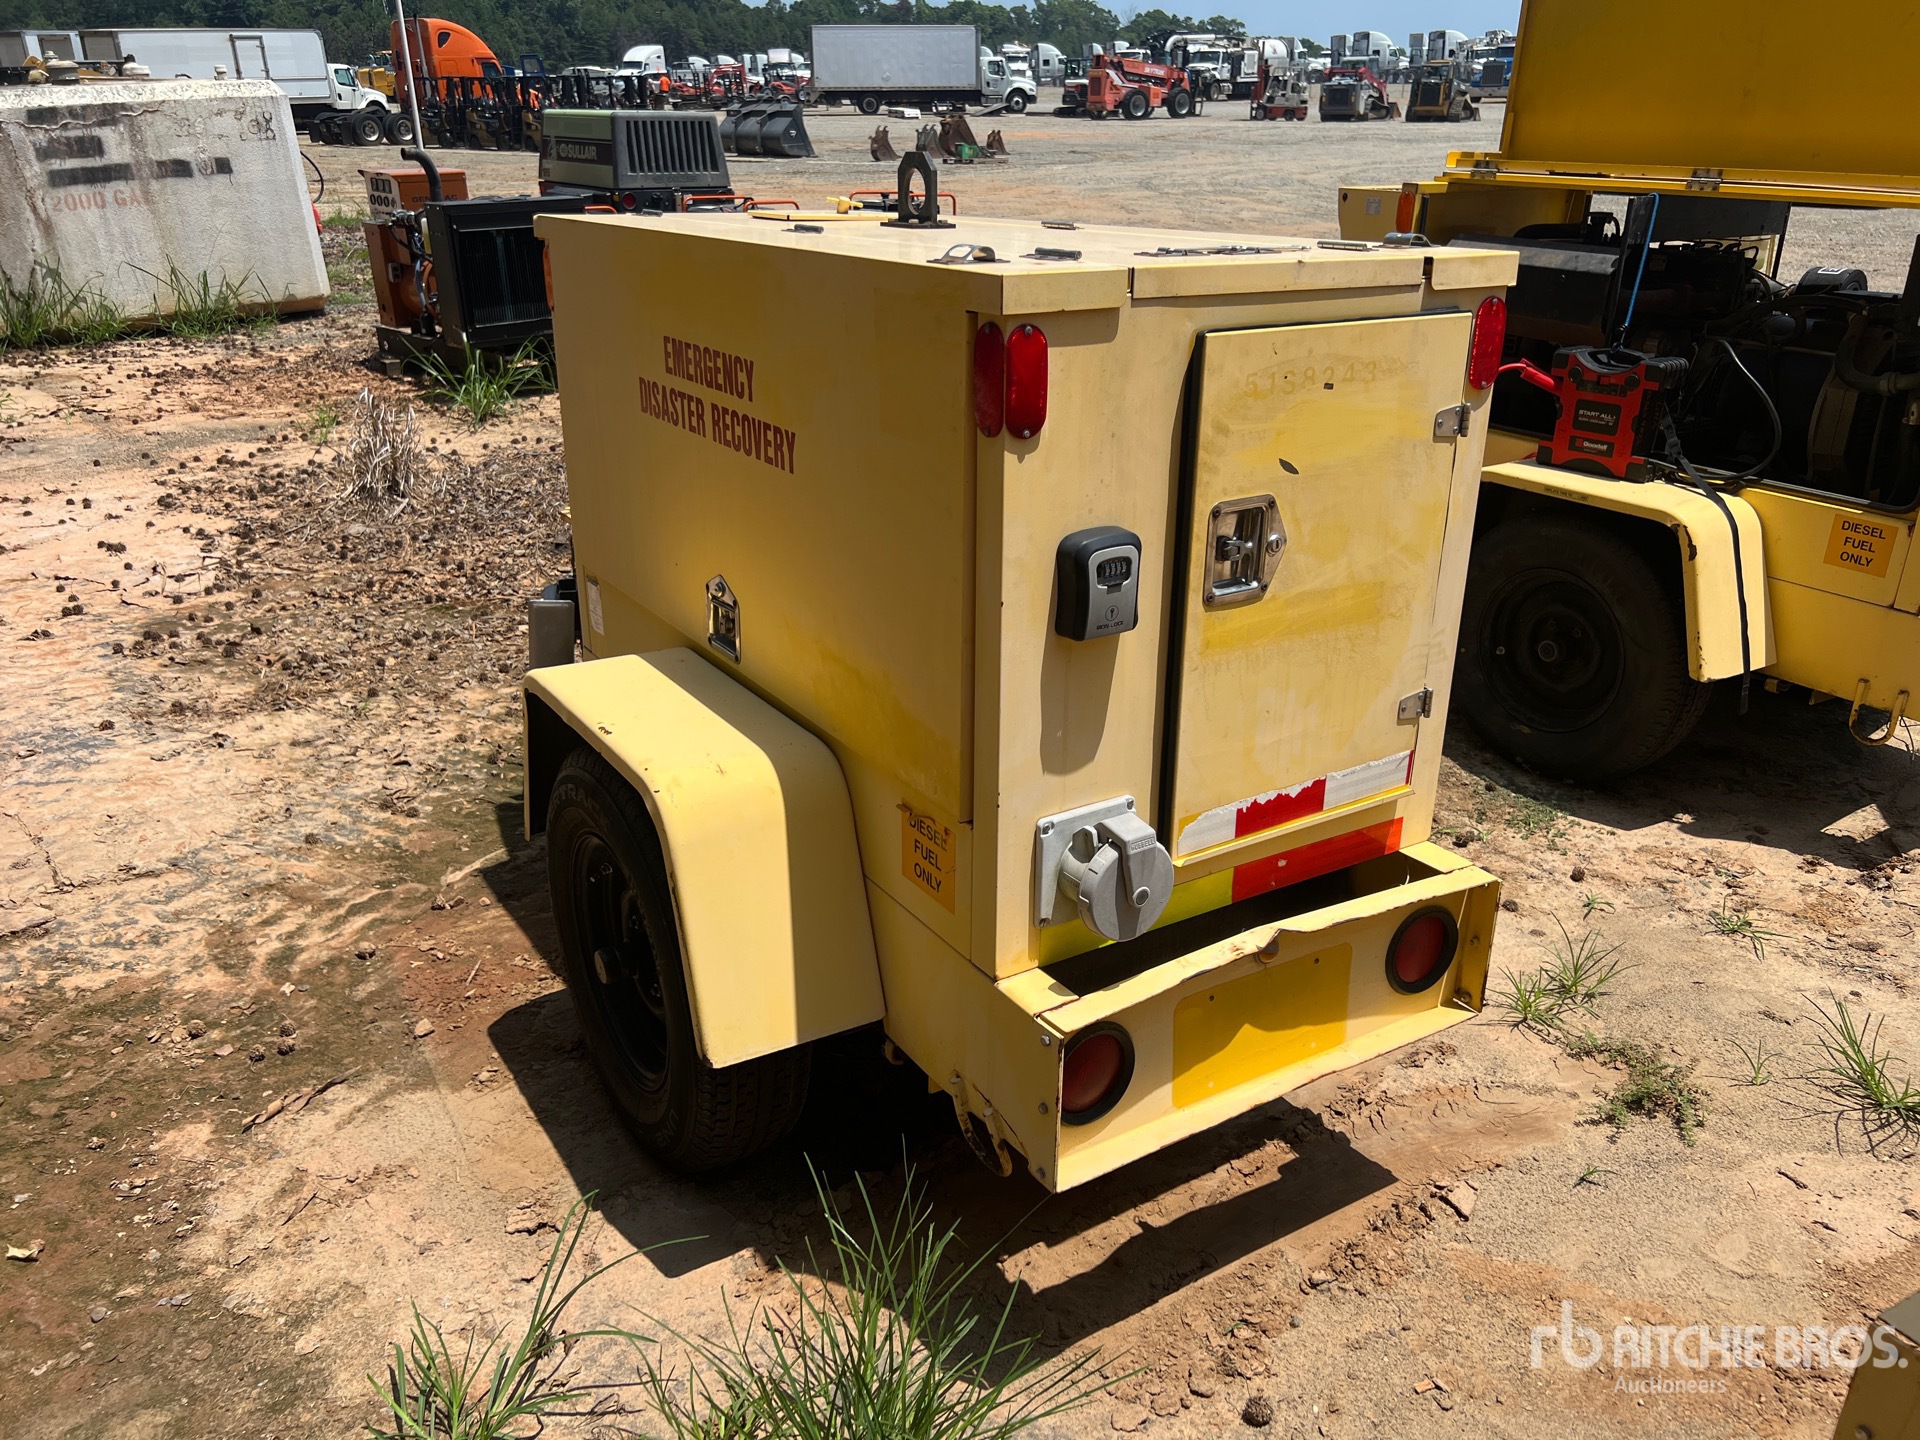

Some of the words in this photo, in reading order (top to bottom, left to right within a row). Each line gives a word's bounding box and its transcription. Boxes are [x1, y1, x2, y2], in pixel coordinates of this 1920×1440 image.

[567, 143, 598, 160] SULLAIR
[663, 335, 755, 403] EMERGENCY
[638, 376, 707, 438] DISASTER
[711, 402, 796, 475] RECOVERY
[1578, 409, 1600, 418] START
[1841, 520, 1886, 540] DIESEL
[1843, 536, 1876, 553] FUEL
[1839, 551, 1873, 567] ONLY
[908, 817, 948, 853] DIESEL
[914, 838, 942, 872] FUEL
[913, 862, 942, 893] ONLY
